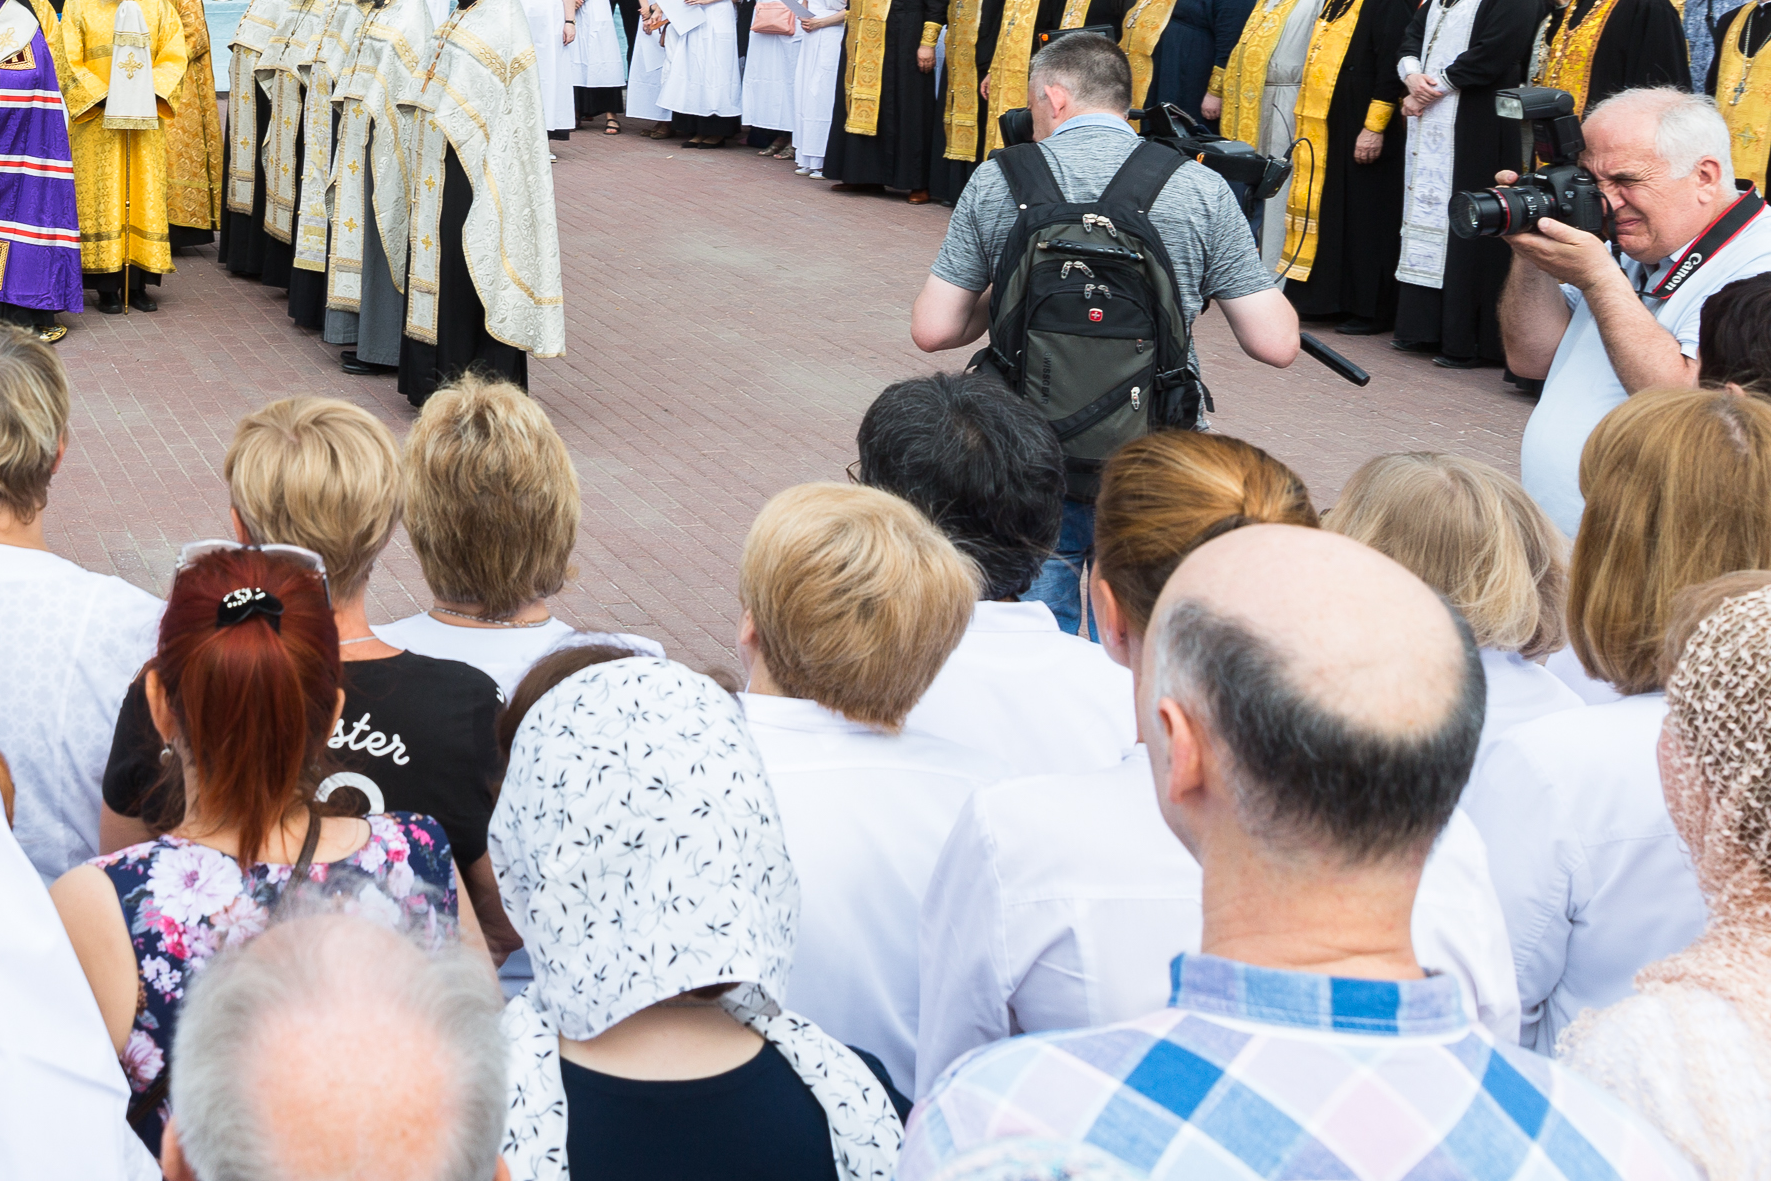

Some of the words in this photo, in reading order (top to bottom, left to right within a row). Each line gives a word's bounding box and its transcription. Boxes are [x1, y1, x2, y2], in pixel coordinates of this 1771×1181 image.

[1664, 252, 1703, 291] Canon
[1040, 351, 1052, 405] SWISSGEAR
[327, 712, 411, 766] ster
